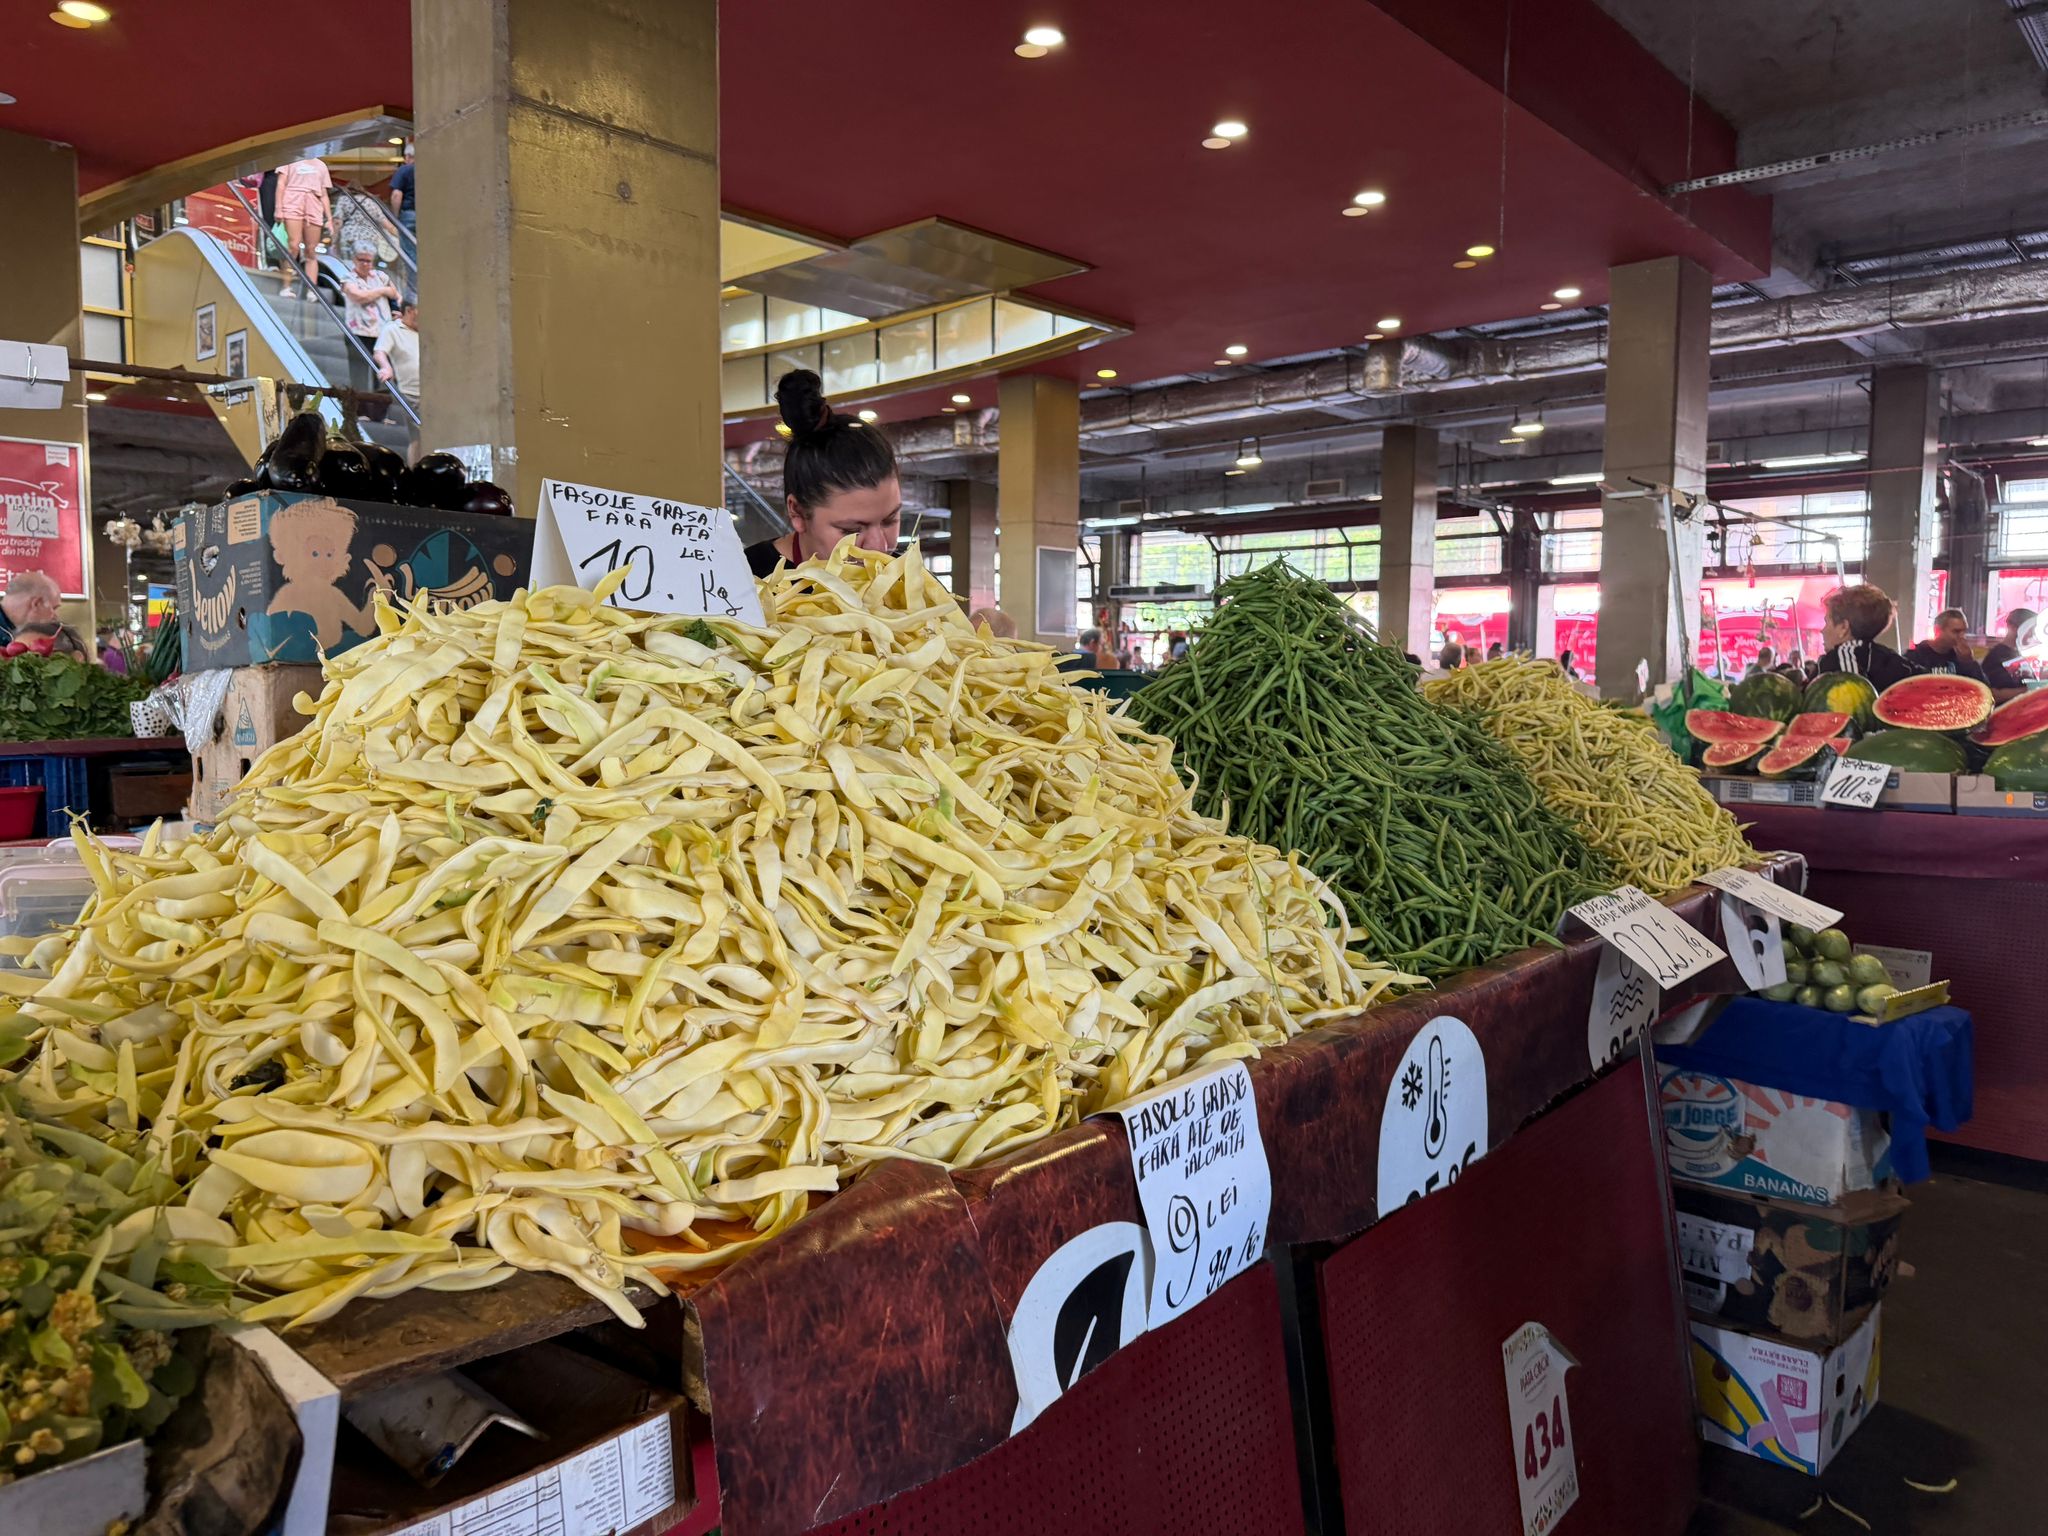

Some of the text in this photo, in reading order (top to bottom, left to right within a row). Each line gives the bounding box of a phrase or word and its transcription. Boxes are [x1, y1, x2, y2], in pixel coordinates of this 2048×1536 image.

[552, 483, 636, 510] FASOLE
[1829, 774, 1866, 798] 10
[1128, 1069, 1247, 1151] FASOLE GRASE
[1220, 1107, 1242, 1136] DE
[1743, 1173, 1829, 1202] BANANAS
[1523, 1394, 1566, 1481] 434
